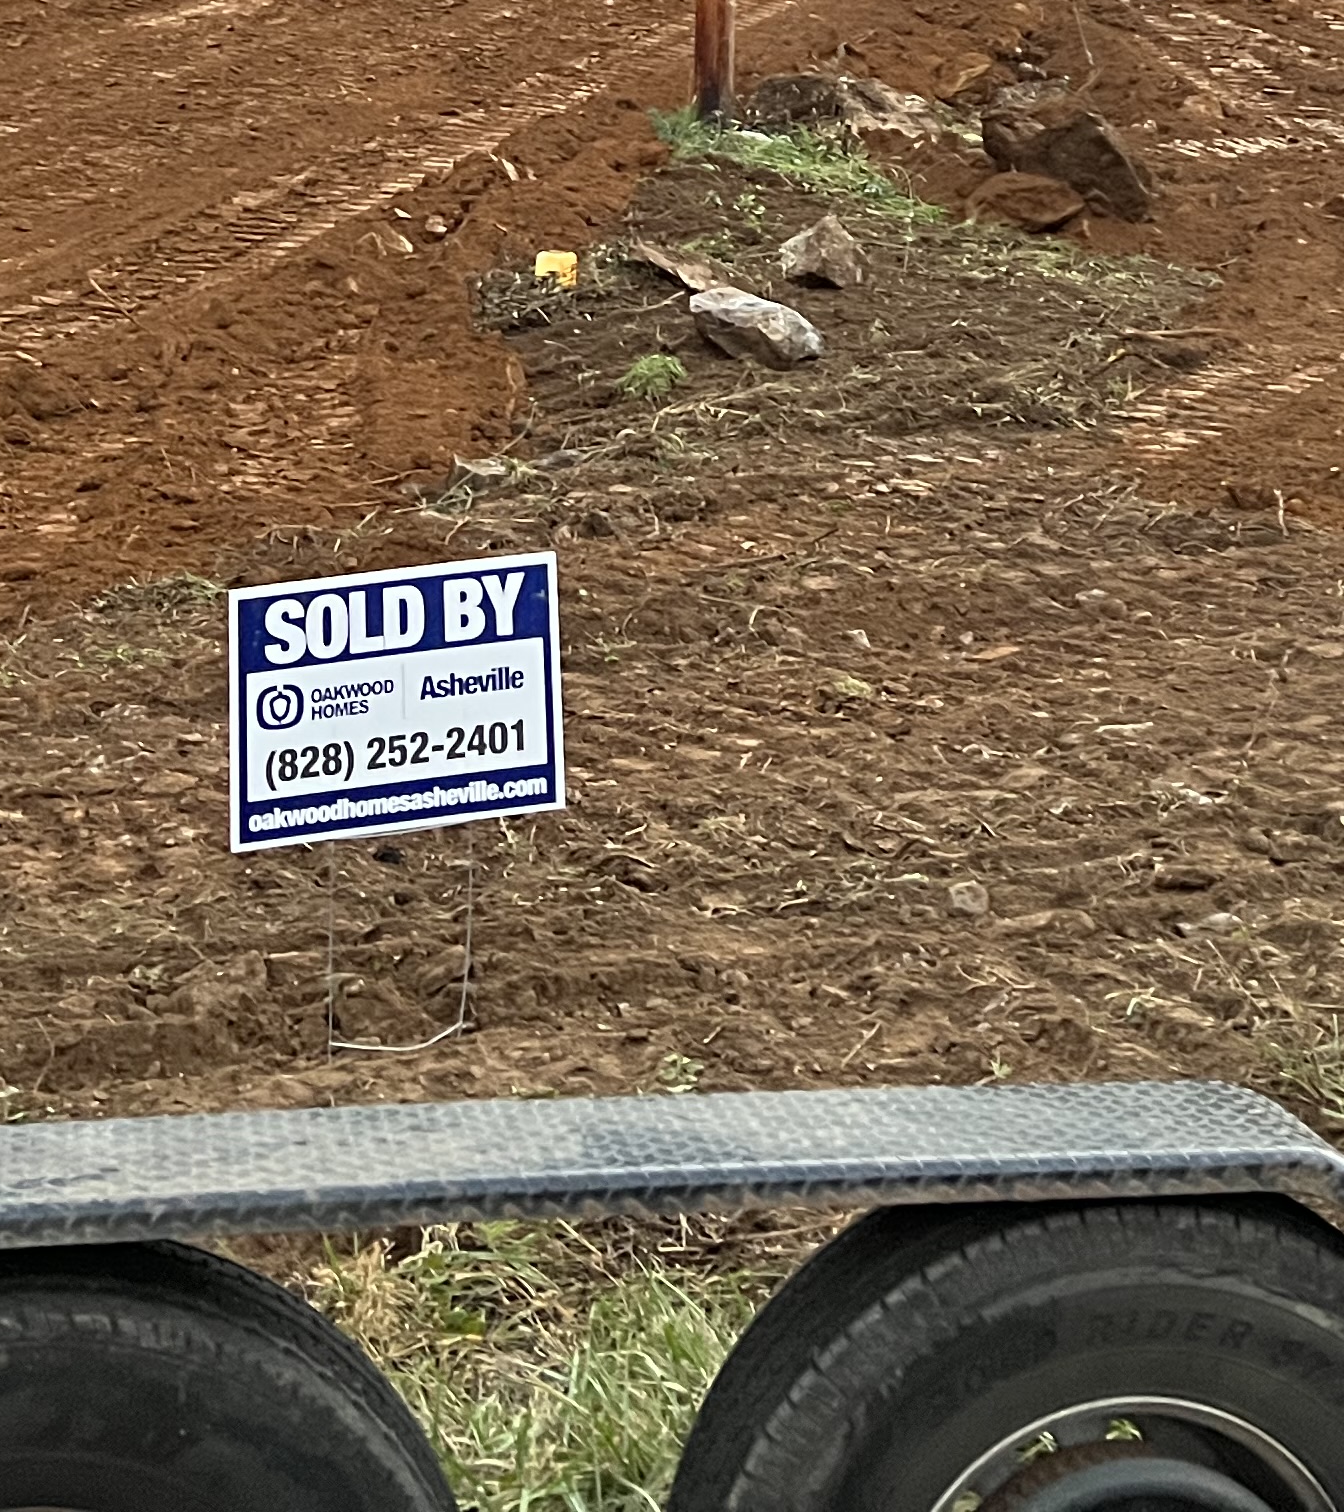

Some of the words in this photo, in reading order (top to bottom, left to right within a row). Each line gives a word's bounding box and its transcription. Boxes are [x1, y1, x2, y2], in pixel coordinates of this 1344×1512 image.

[264, 584, 425, 665] SOLD
[443, 571, 525, 642] BY
[311, 679, 394, 704] OAKWOOD
[420, 666, 524, 700] Asheville
[311, 700, 369, 720] HOMES
[265, 741, 355, 791] (828)
[367, 719, 525, 770] 252-2401
[248, 776, 548, 833] oakwoodhomesasheville.com
[1079, 1306, 1254, 1356] RIDER
